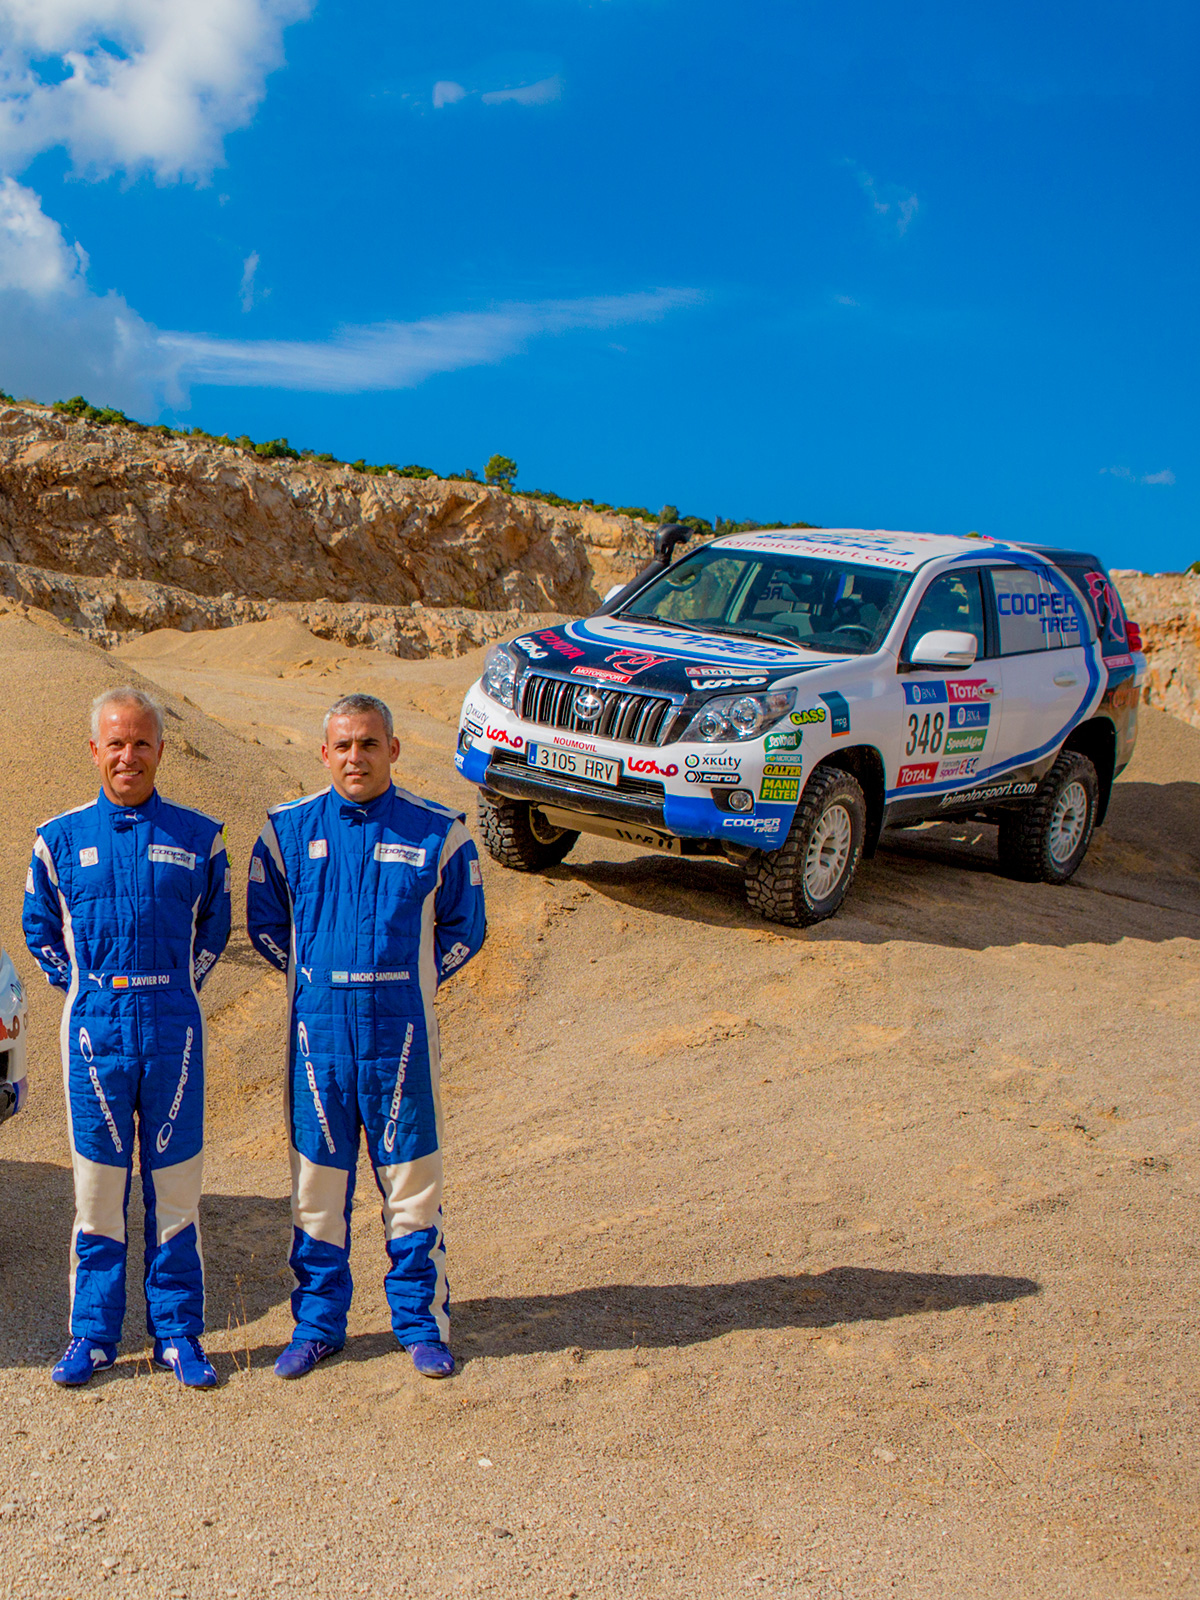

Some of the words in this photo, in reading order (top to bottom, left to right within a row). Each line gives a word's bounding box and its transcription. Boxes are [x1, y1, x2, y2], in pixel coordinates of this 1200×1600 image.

[721, 539, 909, 568] fojmotorsport.com
[998, 593, 1077, 616] COOPER
[1039, 616, 1080, 634] TIRES
[535, 630, 586, 660] TOYOTA
[603, 624, 800, 657] COOPER
[575, 666, 627, 683] MOTORSPORT
[921, 687, 937, 699] BNA
[789, 706, 827, 726] GASS
[905, 711, 945, 757] 348
[553, 735, 598, 753] NOUMOVIL
[946, 736, 984, 752] SpeedAgro
[540, 749, 577, 772] 3105
[584, 758, 614, 782] HRV
[702, 756, 742, 771] xkuty
[763, 763, 802, 777] GALFER
[901, 768, 932, 784] TOTAL
[763, 779, 799, 790] MANN
[761, 789, 798, 800] FILTER
[722, 817, 782, 828] COOPER
[752, 826, 780, 834] TIRES
[151, 848, 192, 860] COOPER
[379, 847, 421, 859] COOPER
[131, 975, 157, 987] XAVIER
[157, 974, 170, 985] FOJ
[350, 971, 375, 983] NACHO
[375, 970, 410, 982] SANTAMARIA
